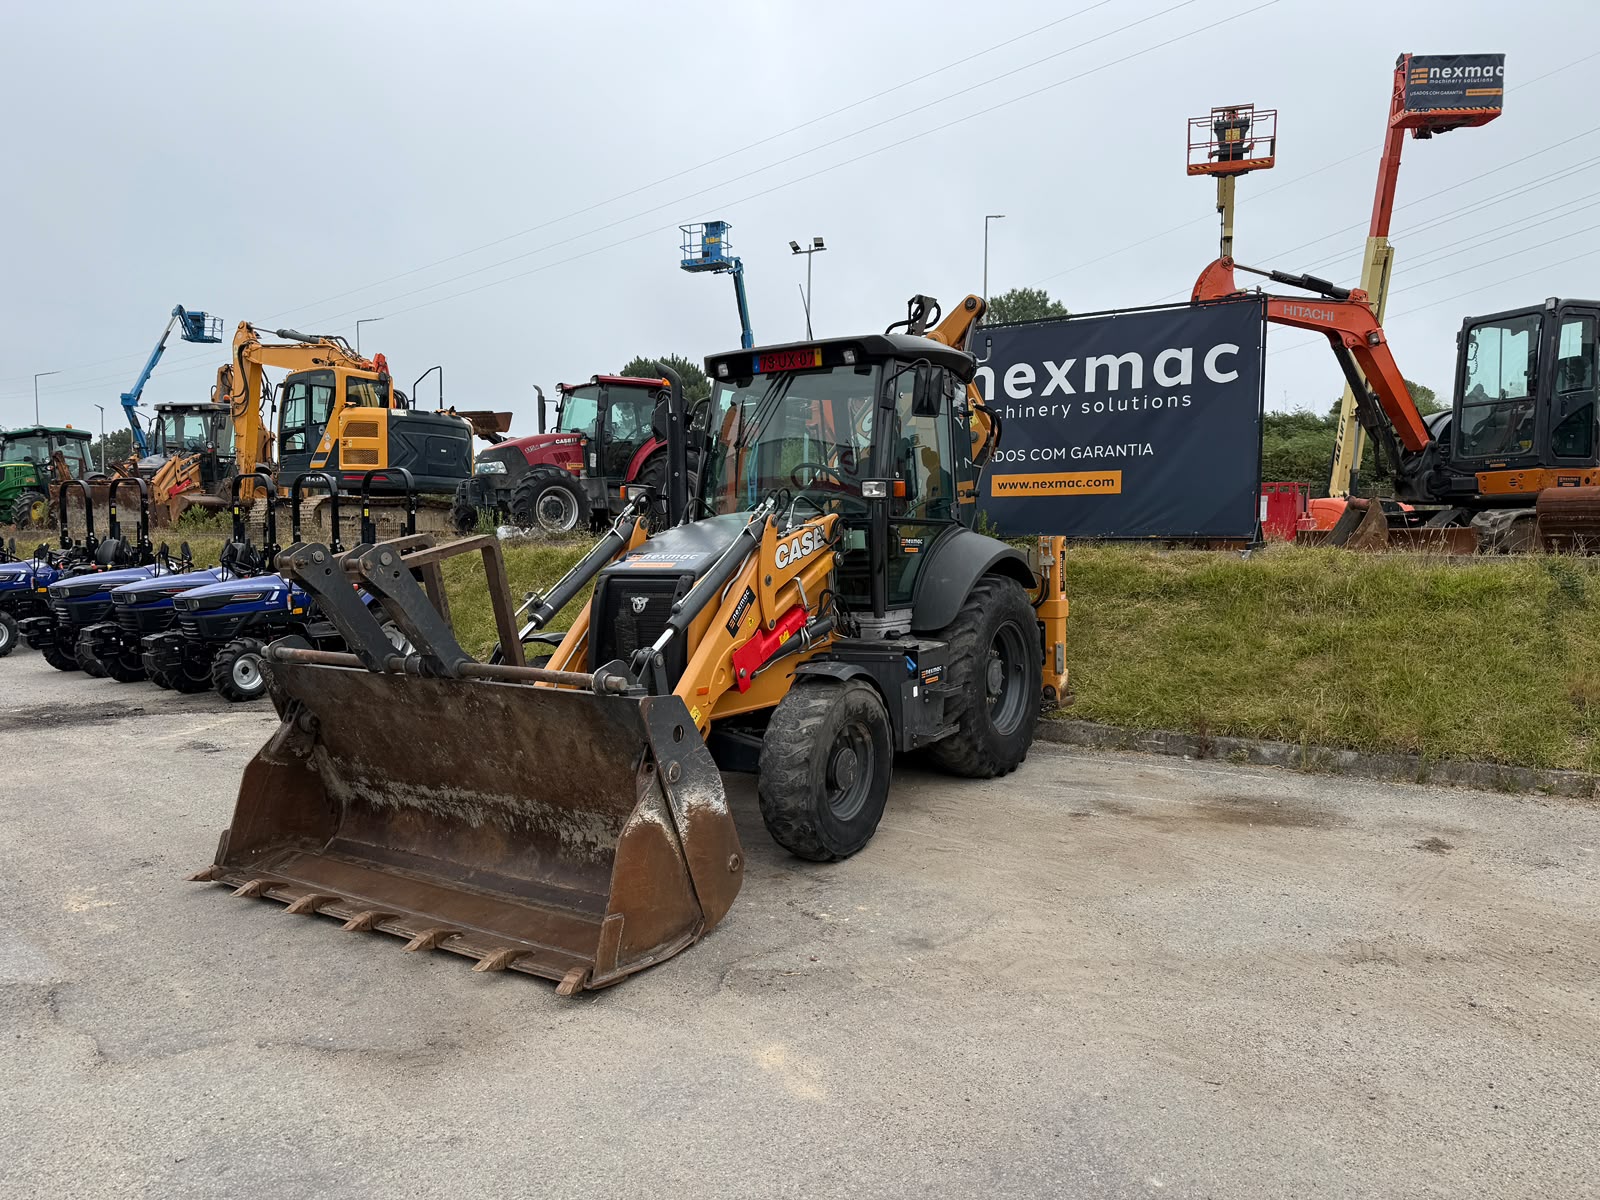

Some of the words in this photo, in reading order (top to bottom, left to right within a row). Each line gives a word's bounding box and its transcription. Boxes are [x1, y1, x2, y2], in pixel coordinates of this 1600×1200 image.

[1429, 65, 1504, 78] nexmac
[1283, 304, 1335, 322] HITACHI
[995, 404, 1072, 419] chinery
[1081, 393, 1192, 414] solutions
[1030, 447, 1065, 461] COM
[1070, 443, 1154, 459] GARANTIA
[997, 477, 1115, 490] www.nexmac.com
[775, 524, 825, 569] CASE
[732, 589, 750, 621] nexmac
